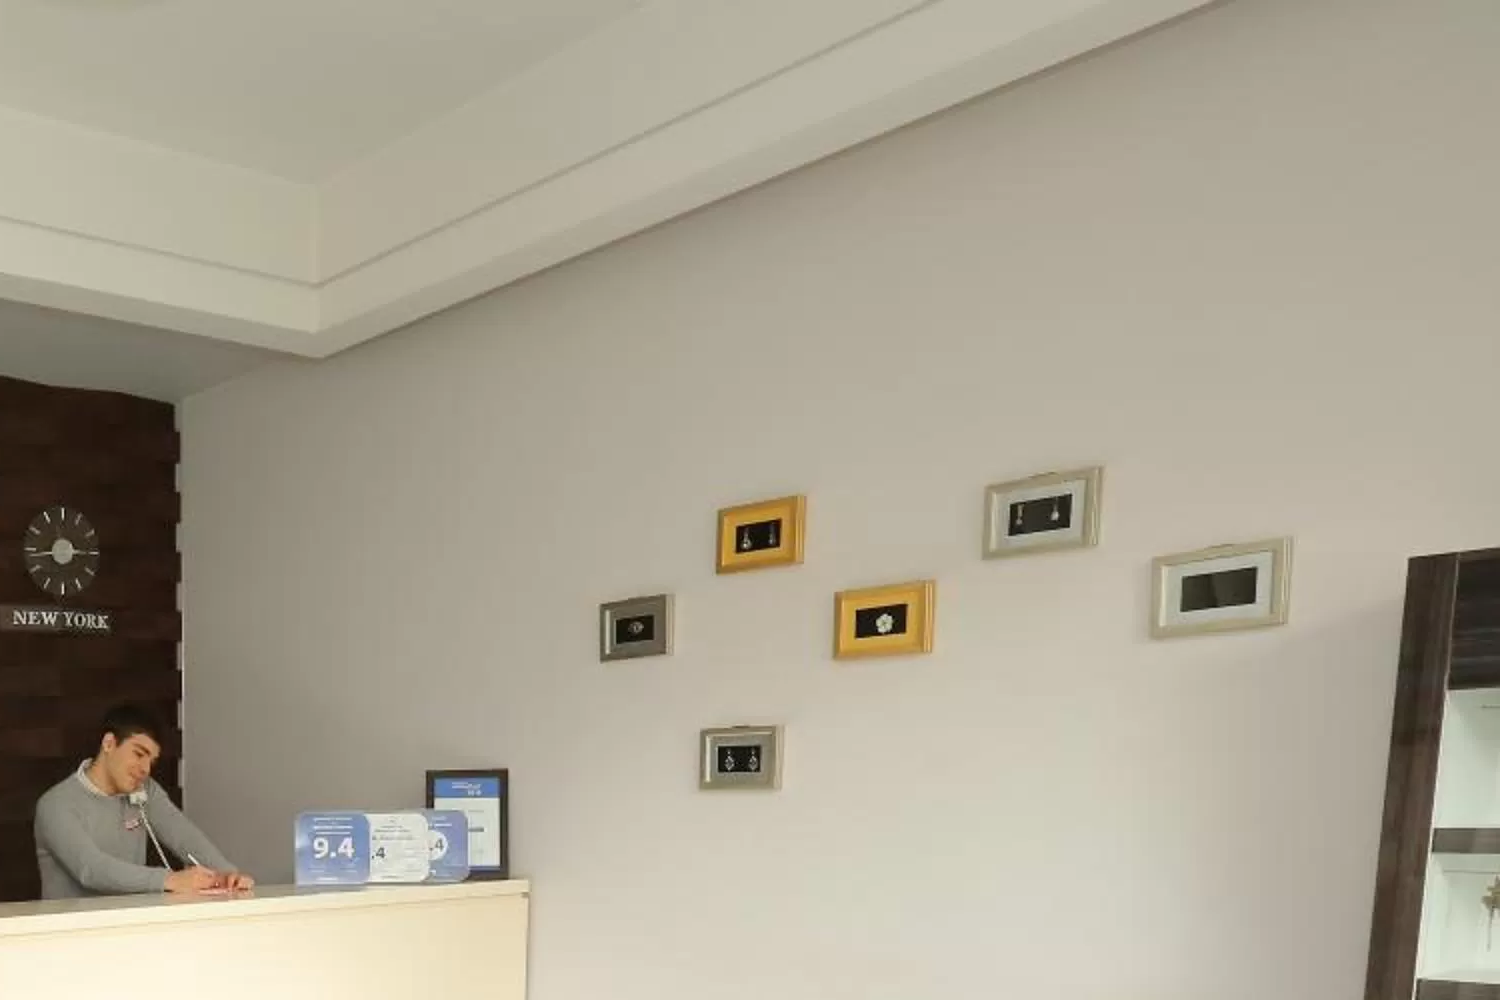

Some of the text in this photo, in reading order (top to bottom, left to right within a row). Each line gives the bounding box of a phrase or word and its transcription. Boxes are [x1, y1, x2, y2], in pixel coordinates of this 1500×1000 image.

[11, 610, 110, 630] NEW YORK
[312, 836, 356, 860] 9.4
